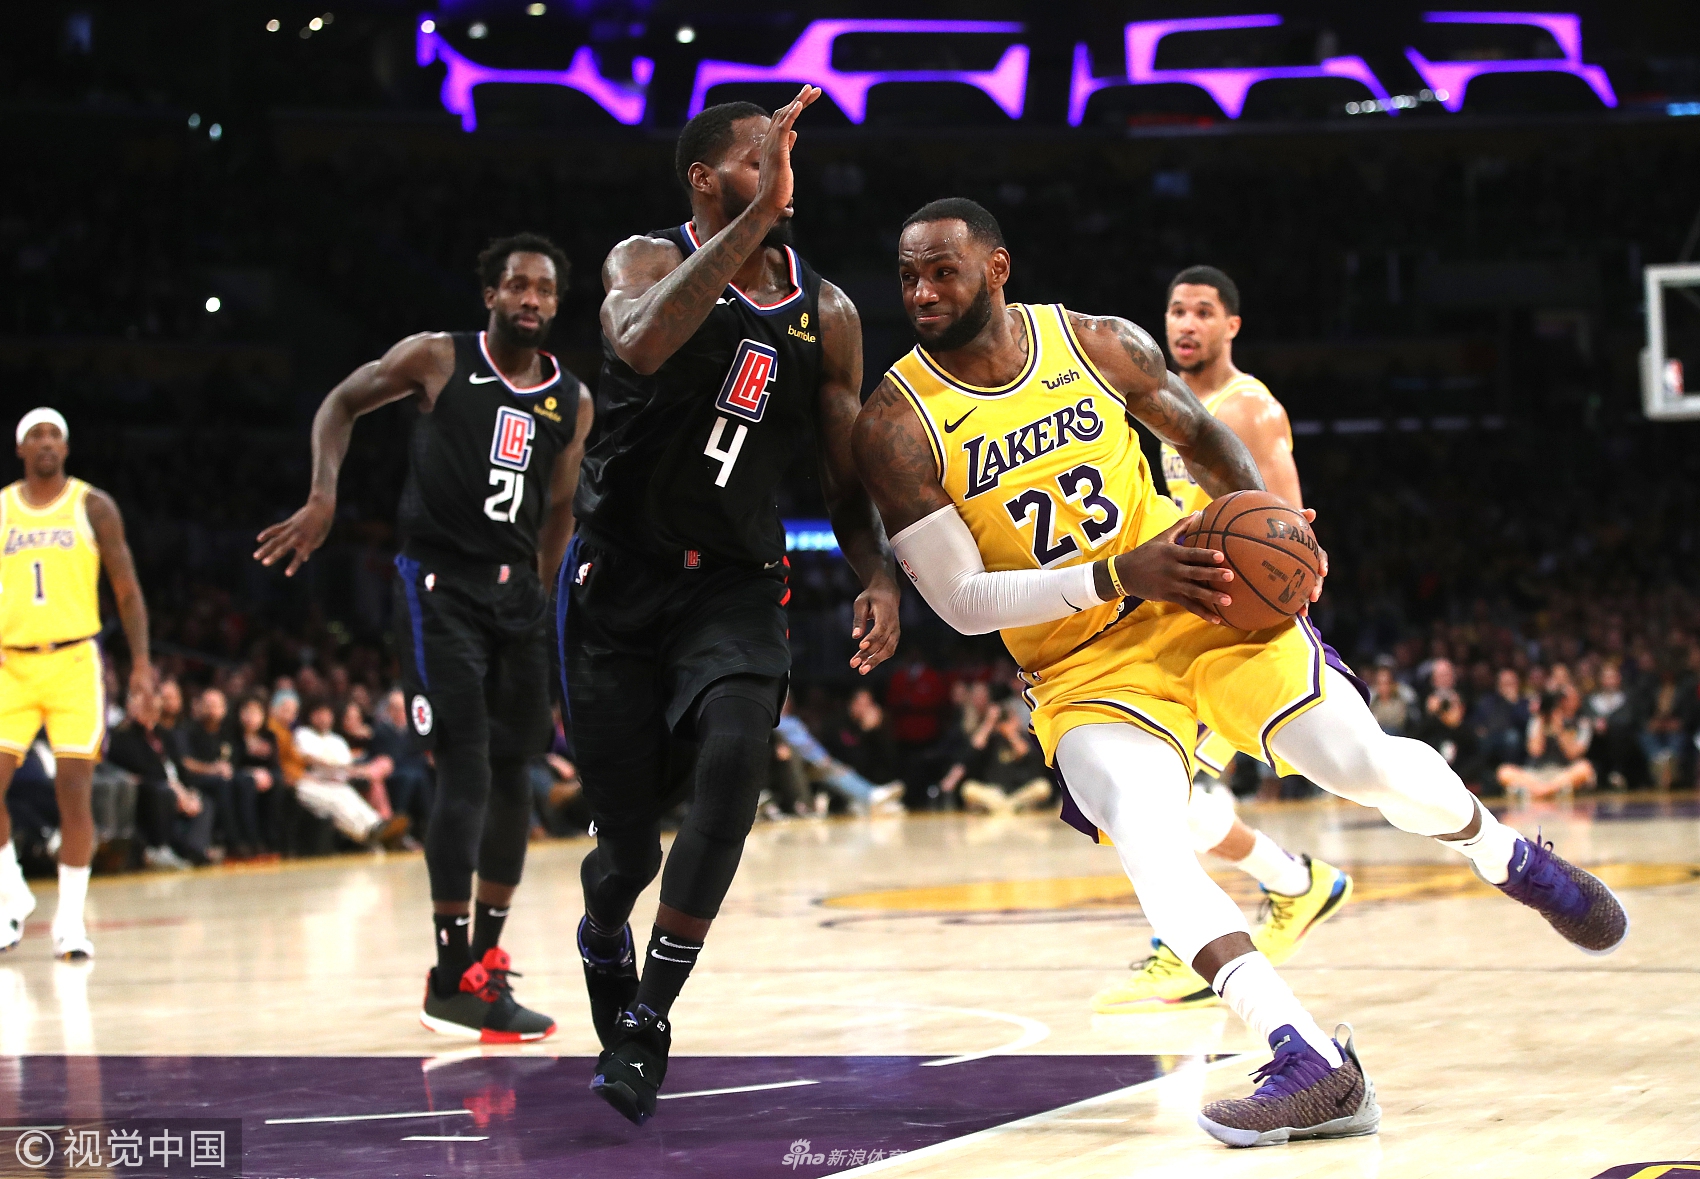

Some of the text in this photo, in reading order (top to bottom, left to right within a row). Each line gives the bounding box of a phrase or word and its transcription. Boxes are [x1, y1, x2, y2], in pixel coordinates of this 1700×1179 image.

[788, 325, 816, 343] bumble
[1041, 369, 1080, 390] wish
[703, 416, 748, 488] 4
[962, 398, 1104, 500] LAKERS
[483, 468, 525, 523] 21
[1003, 464, 1123, 570] 23
[33, 562, 46, 602] 1
